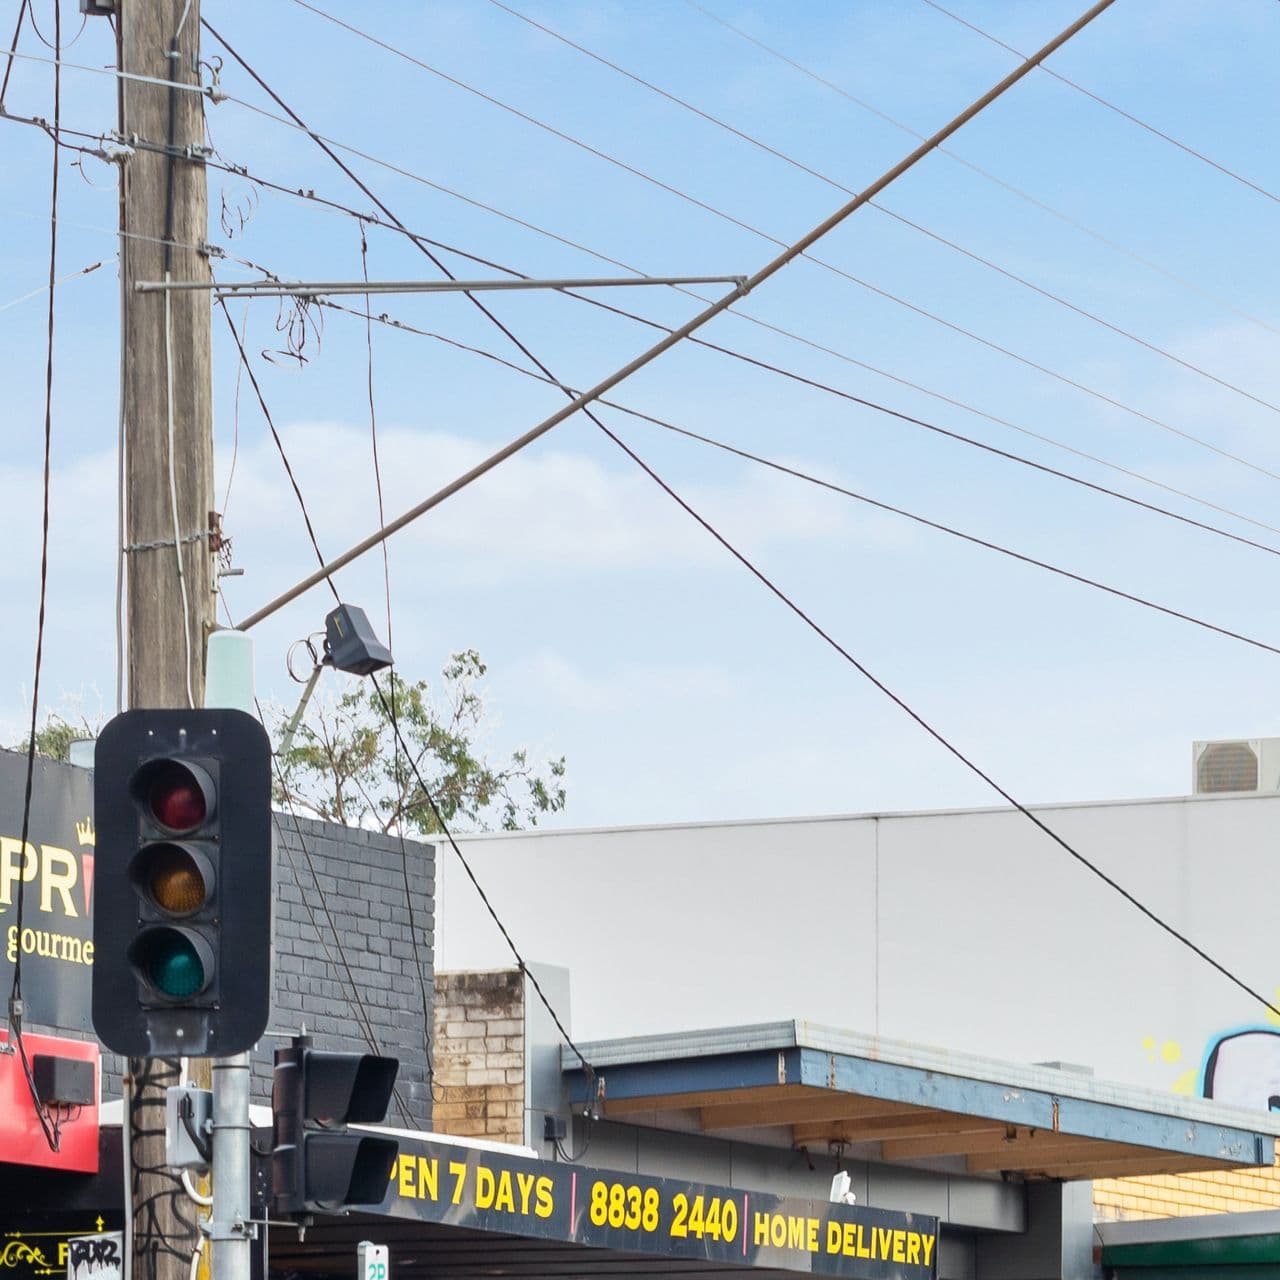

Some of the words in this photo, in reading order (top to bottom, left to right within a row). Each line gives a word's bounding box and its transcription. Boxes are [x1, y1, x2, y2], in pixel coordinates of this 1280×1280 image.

[0, 835, 95, 918] PRI
[6, 924, 95, 966] gourme
[391, 1153, 439, 1202] EN
[449, 1161, 467, 1205] 7
[475, 1165, 554, 1219] DAYS
[589, 1180, 660, 1233] 8838
[670, 1191, 738, 1243] 2440
[753, 1211, 820, 1253] HOME
[825, 1220, 936, 1267] DELIVERY
